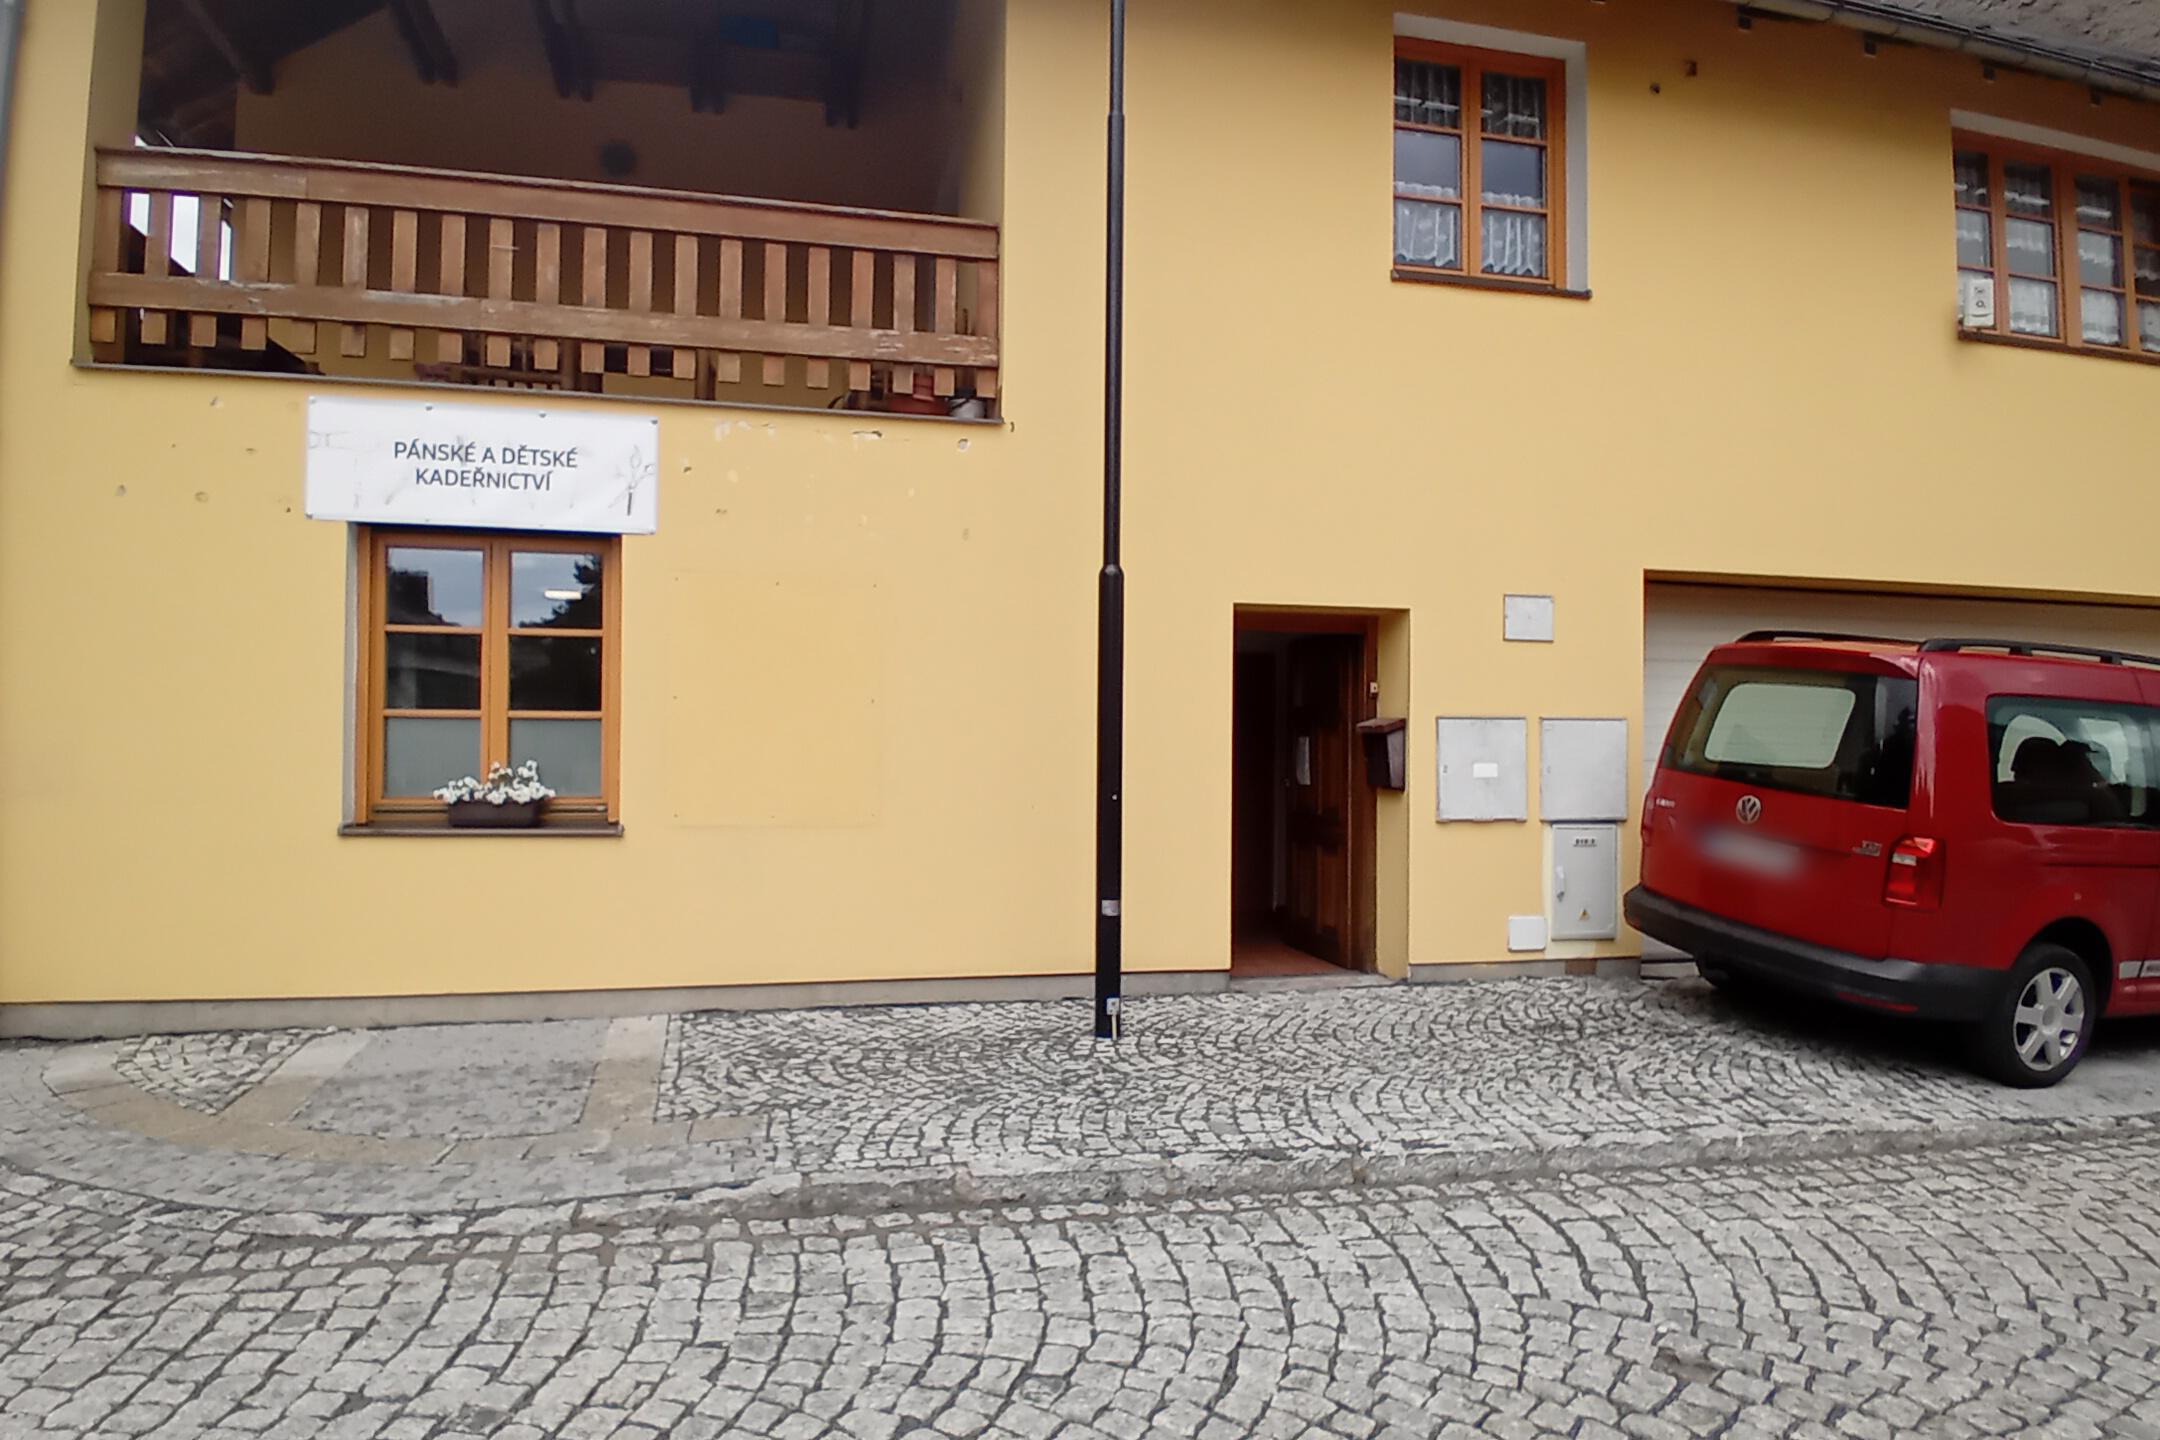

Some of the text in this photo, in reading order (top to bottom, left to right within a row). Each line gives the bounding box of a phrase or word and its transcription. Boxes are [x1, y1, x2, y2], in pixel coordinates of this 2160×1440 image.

[394, 438, 578, 468] PÁNSKÉ A DĚTSKÉ
[416, 467, 553, 491] KADEŘNICTVÍ
